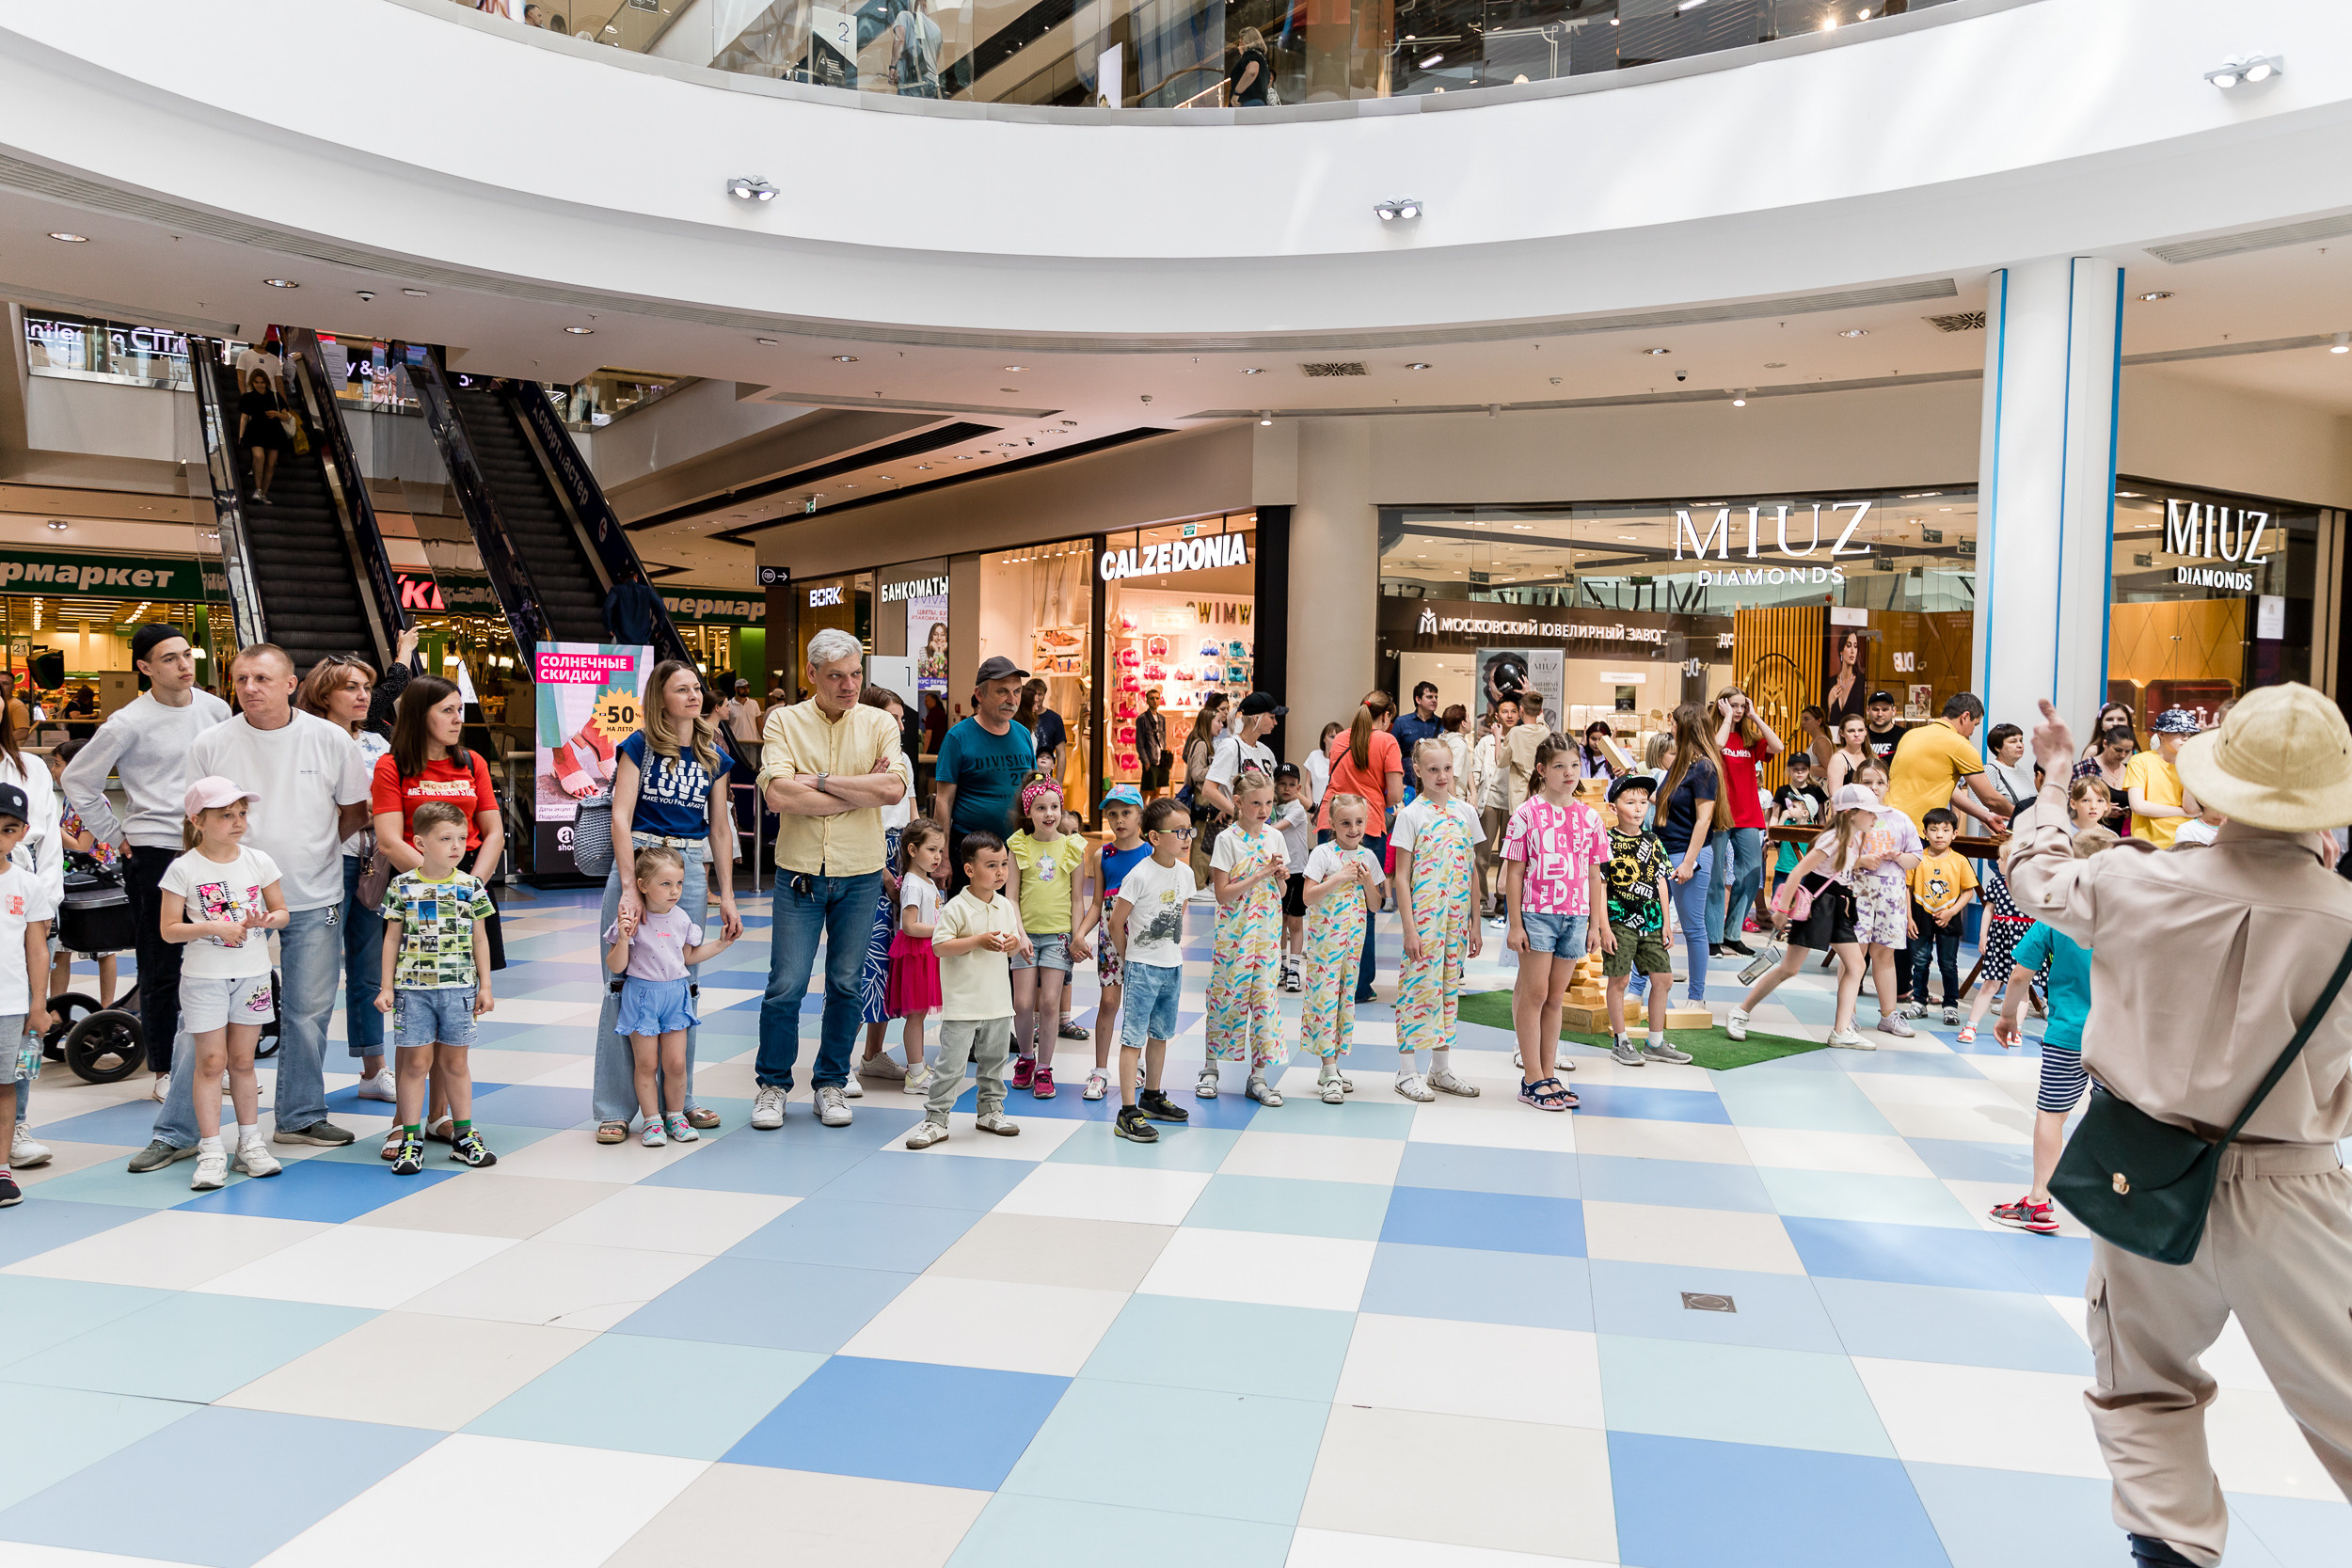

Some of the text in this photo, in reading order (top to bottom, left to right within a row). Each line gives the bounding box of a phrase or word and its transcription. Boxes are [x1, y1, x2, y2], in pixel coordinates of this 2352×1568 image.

[838, 22, 850, 43] 2
[1674, 501, 1872, 561] MIUZ
[2167, 499, 2269, 564] MIUZ
[1100, 532, 1248, 581] CALZEDONIA
[1698, 566, 1846, 587] DIAMONDS
[2177, 566, 2253, 592] DIAMONDS
[810, 586, 843, 608] BORK
[882, 575, 949, 603] БАНКОМАТЫ
[1438, 617, 1538, 636] МОСКОВСКИЙ
[1540, 623, 1625, 641] ЮВЕЛИРНЫЙ
[13, 643, 27, 653] 21
[540, 656, 628, 670] СОЛНЕЧНЫЕ
[540, 669, 602, 683] СКИДКИ
[904, 666, 911, 687] 1
[976, 753, 1032, 770] DIVISION
[407, 787, 421, 797] ARE
[642, 794, 659, 803] MAKE
[659, 796, 675, 805] YOU
[686, 801, 705, 810] APART
[1539, 808, 1549, 828] FILA
[1571, 811, 1580, 830] FILA
[1572, 832, 1581, 853] FILA
[1540, 884, 1549, 904] FILA
